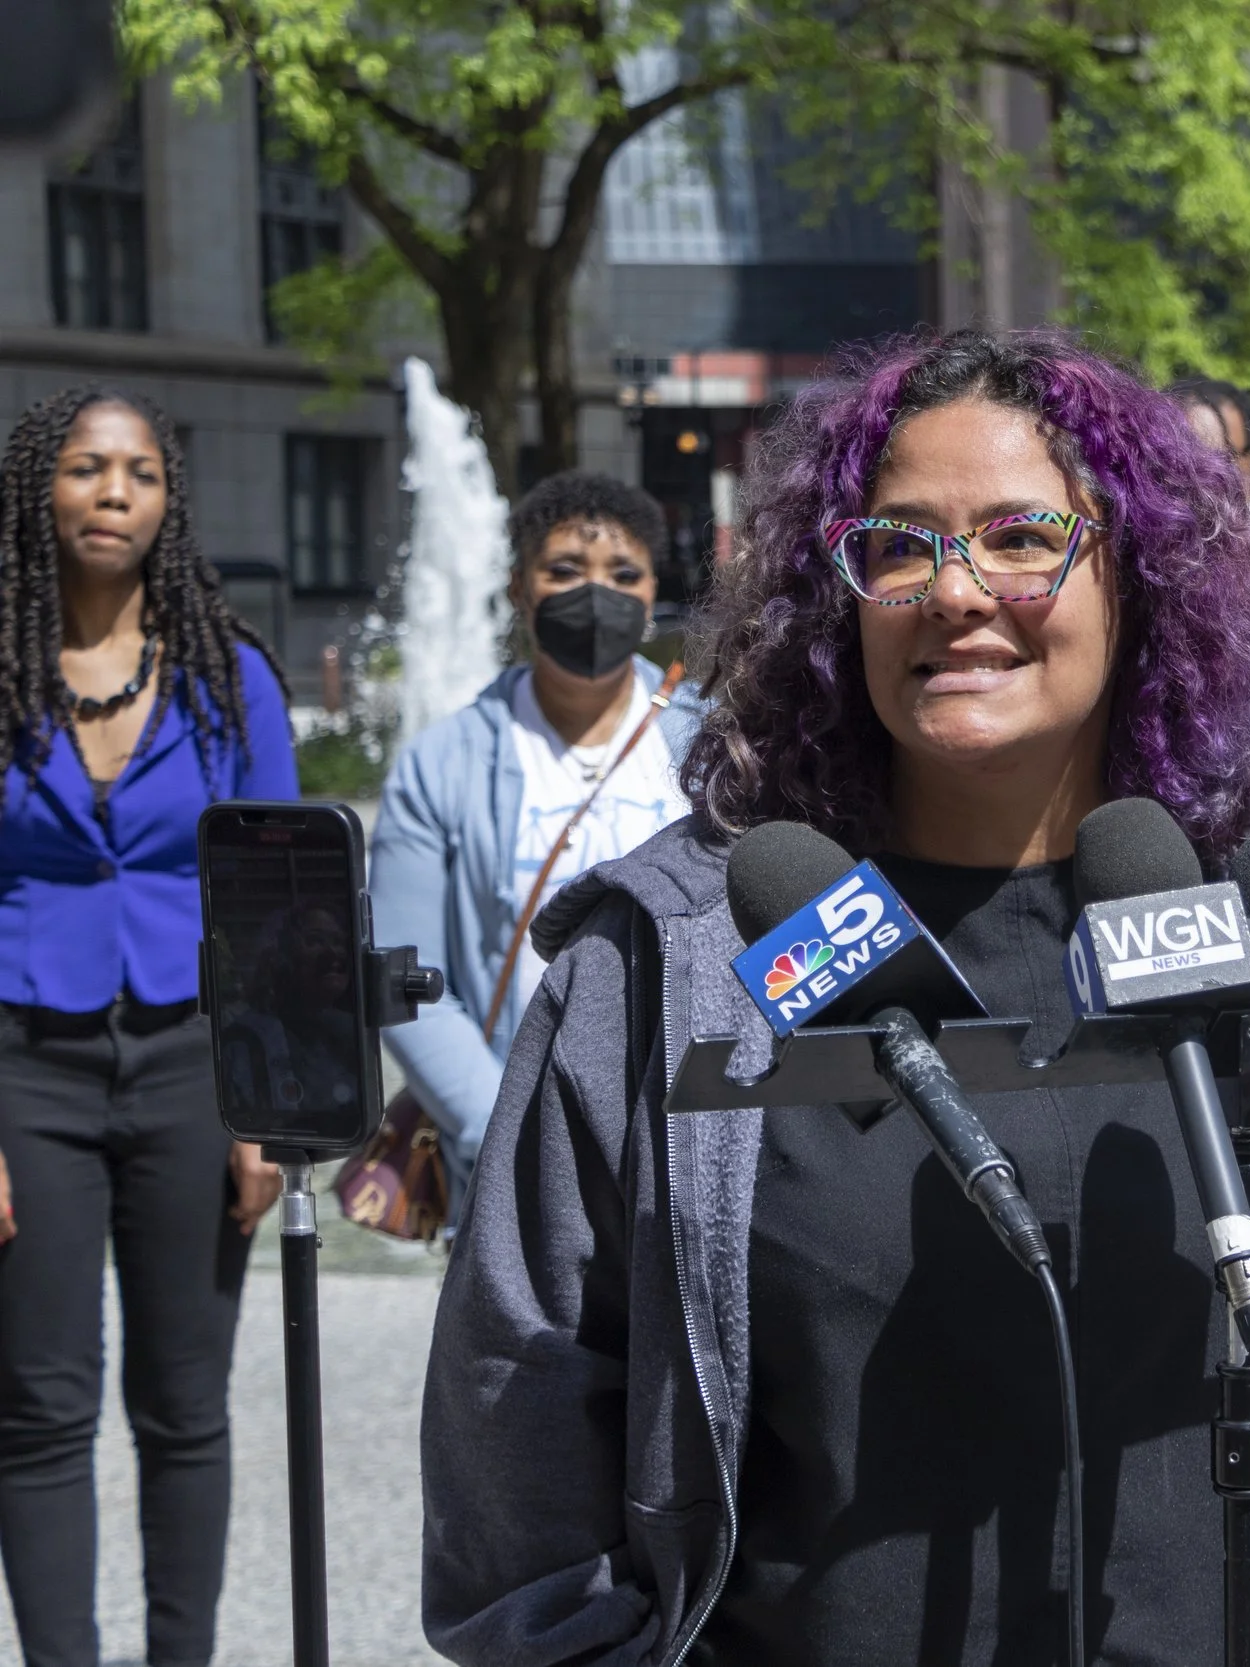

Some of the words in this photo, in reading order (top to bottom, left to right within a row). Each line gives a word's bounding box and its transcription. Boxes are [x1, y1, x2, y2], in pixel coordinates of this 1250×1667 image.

[816, 876, 884, 945] 5
[1098, 900, 1240, 960] WGN
[778, 922, 901, 1021] NEWS
[1152, 952, 1202, 970] NEWS
